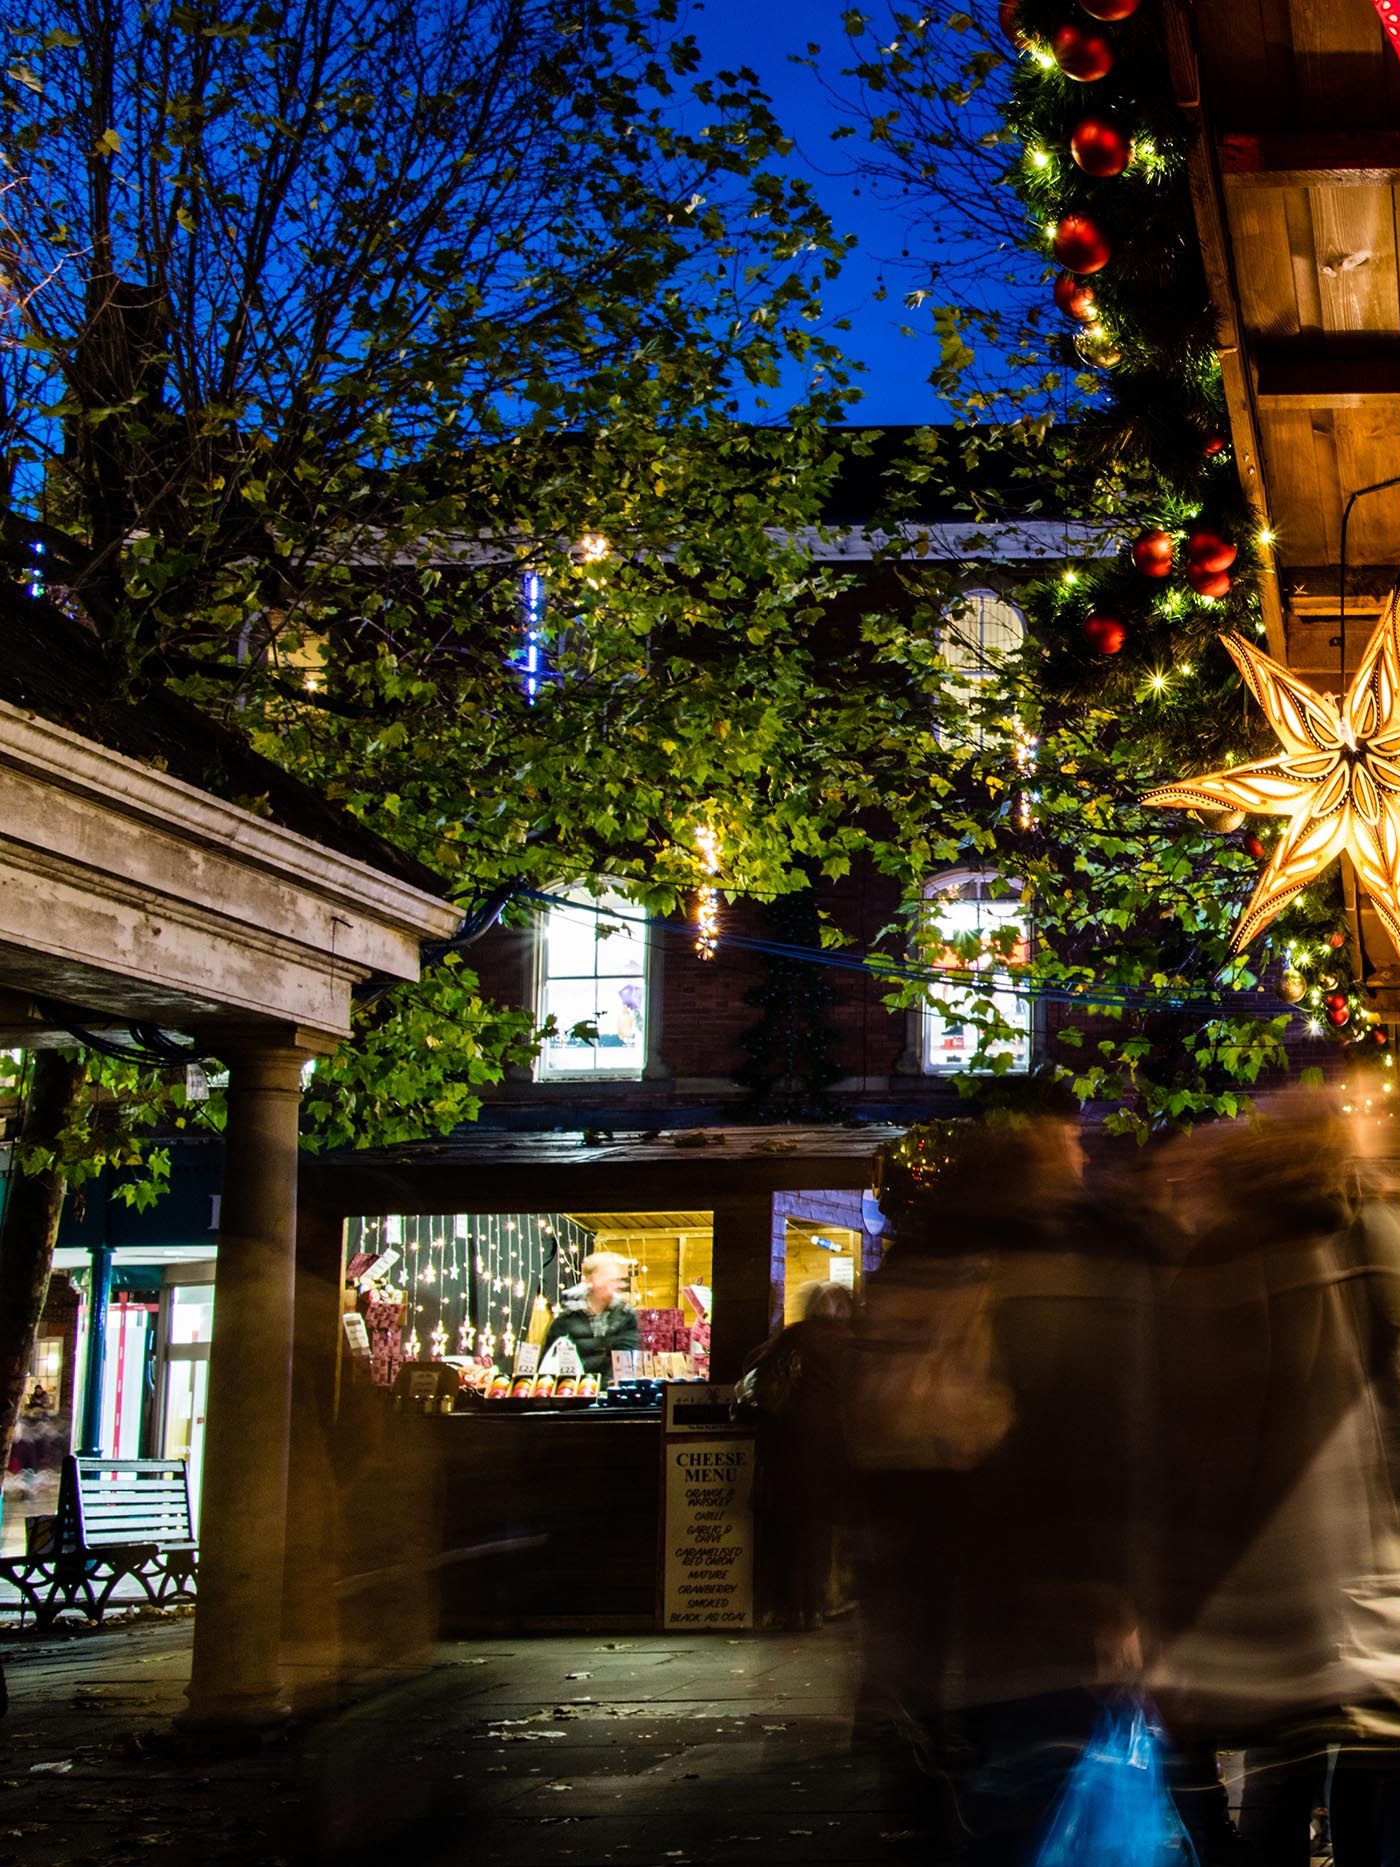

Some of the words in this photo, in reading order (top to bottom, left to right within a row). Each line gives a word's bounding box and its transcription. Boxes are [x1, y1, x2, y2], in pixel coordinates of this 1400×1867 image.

[676, 1452, 747, 1467] CHEESE
[685, 1468, 737, 1482] MENU
[687, 1525, 722, 1535] GARLIC
[682, 1556, 703, 1566] RED
[705, 1556, 735, 1566] ONION
[688, 1570, 728, 1579] MATURE
[678, 1584, 737, 1594] CRANBERRY
[688, 1598, 729, 1608] SMOKED
[670, 1612, 702, 1623] BLACK
[704, 1612, 720, 1622] AS
